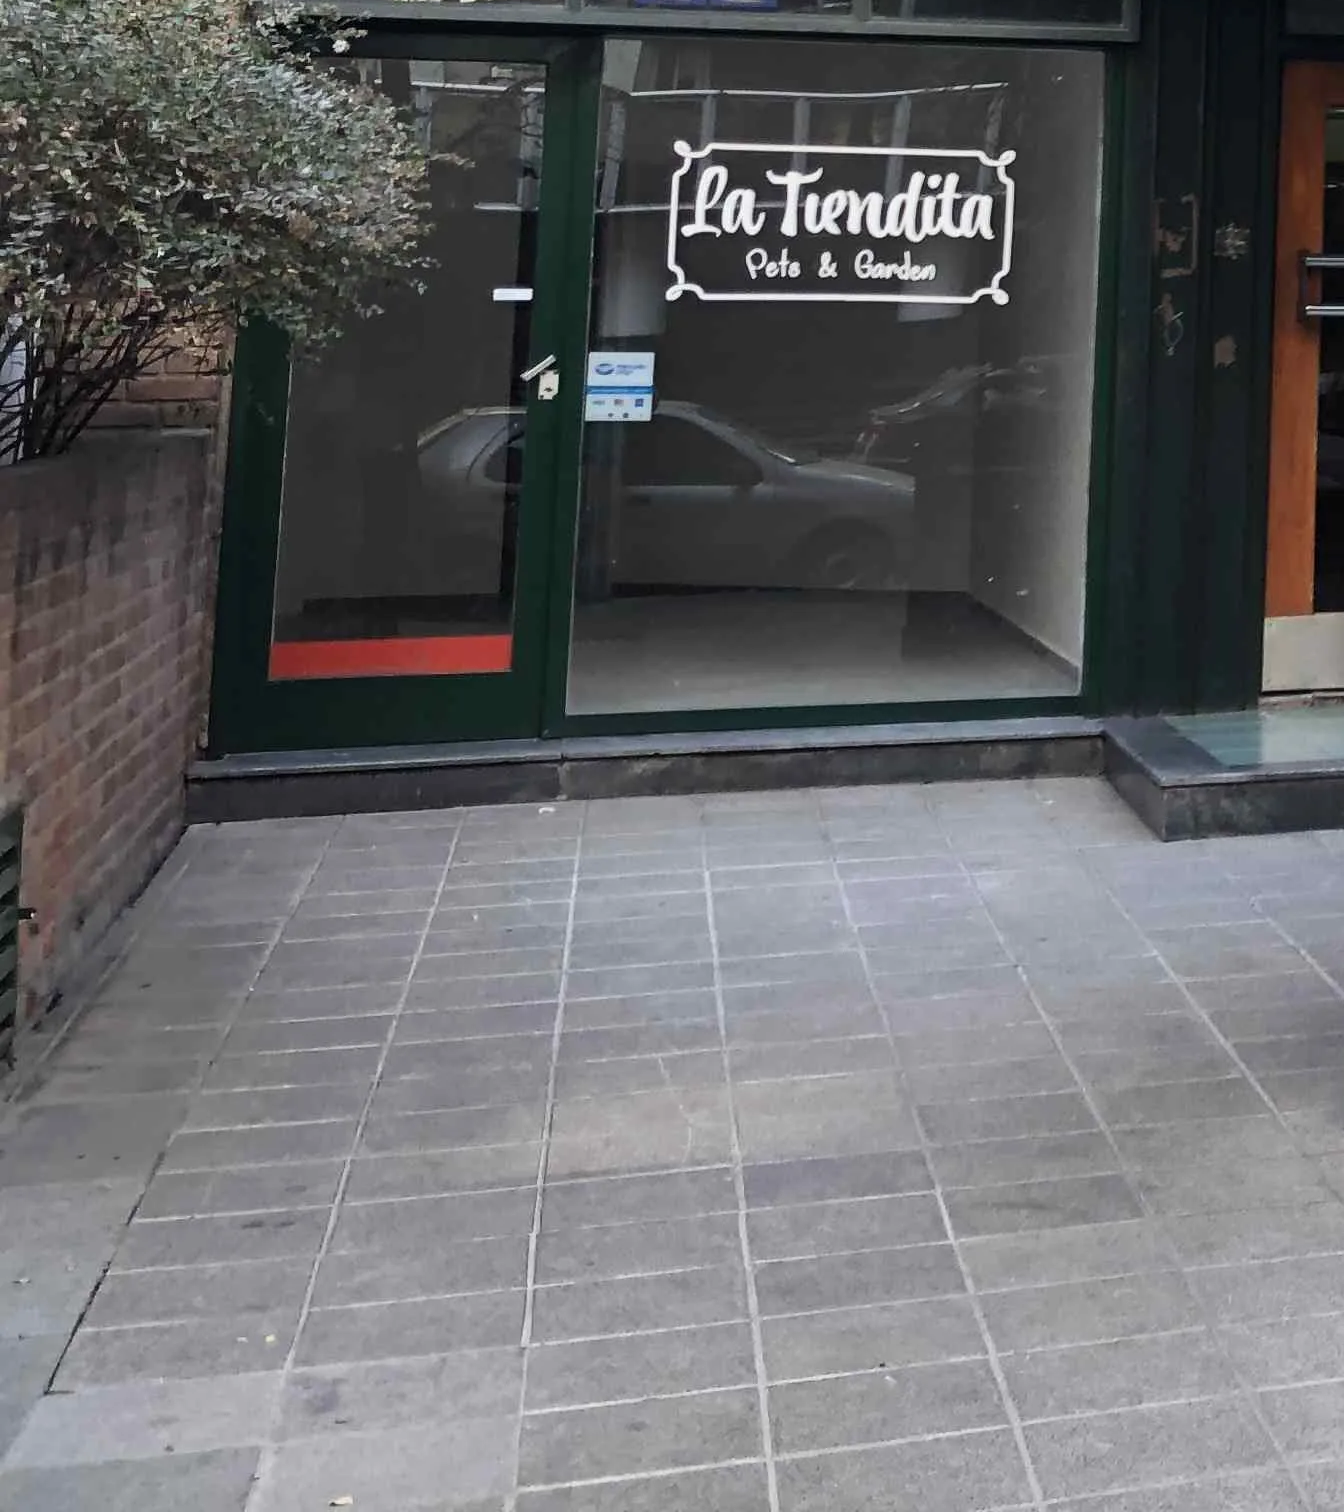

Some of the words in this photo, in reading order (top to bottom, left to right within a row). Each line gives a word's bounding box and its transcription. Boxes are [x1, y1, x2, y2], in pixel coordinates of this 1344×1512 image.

[681, 165, 767, 238] La
[765, 167, 996, 243] Tiendita
[745, 248, 801, 280] Pets
[817, 251, 838, 279] &
[854, 249, 938, 282] Garden
